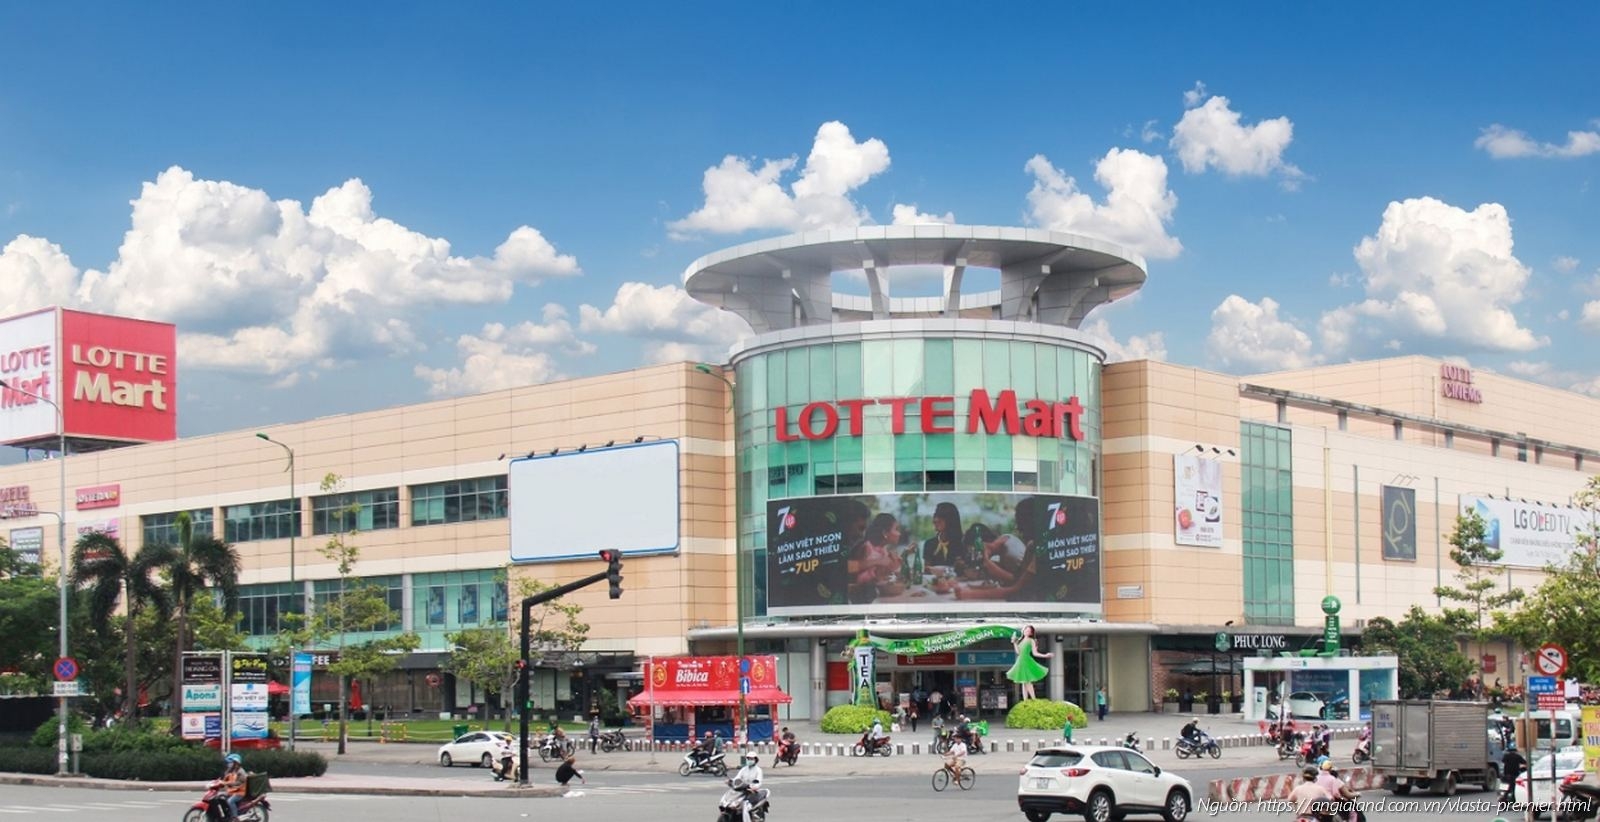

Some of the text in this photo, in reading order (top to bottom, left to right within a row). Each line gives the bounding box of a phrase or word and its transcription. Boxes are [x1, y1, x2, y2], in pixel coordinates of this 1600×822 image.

[1, 345, 51, 373] LOTTE
[72, 344, 167, 375] LOTTE
[1, 371, 51, 409] Mart
[74, 370, 167, 411] Mart
[775, 388, 1085, 442] LOTTE Mart
[1513, 508, 1528, 530] LG
[1529, 510, 1557, 532] OLED
[795, 549, 813, 561] SAO
[1066, 548, 1080, 558] SAO
[795, 559, 819, 574] 7UP
[1066, 558, 1084, 571] 7UP
[1261, 634, 1285, 648] LONG
[675, 669, 709, 683] Bibica
